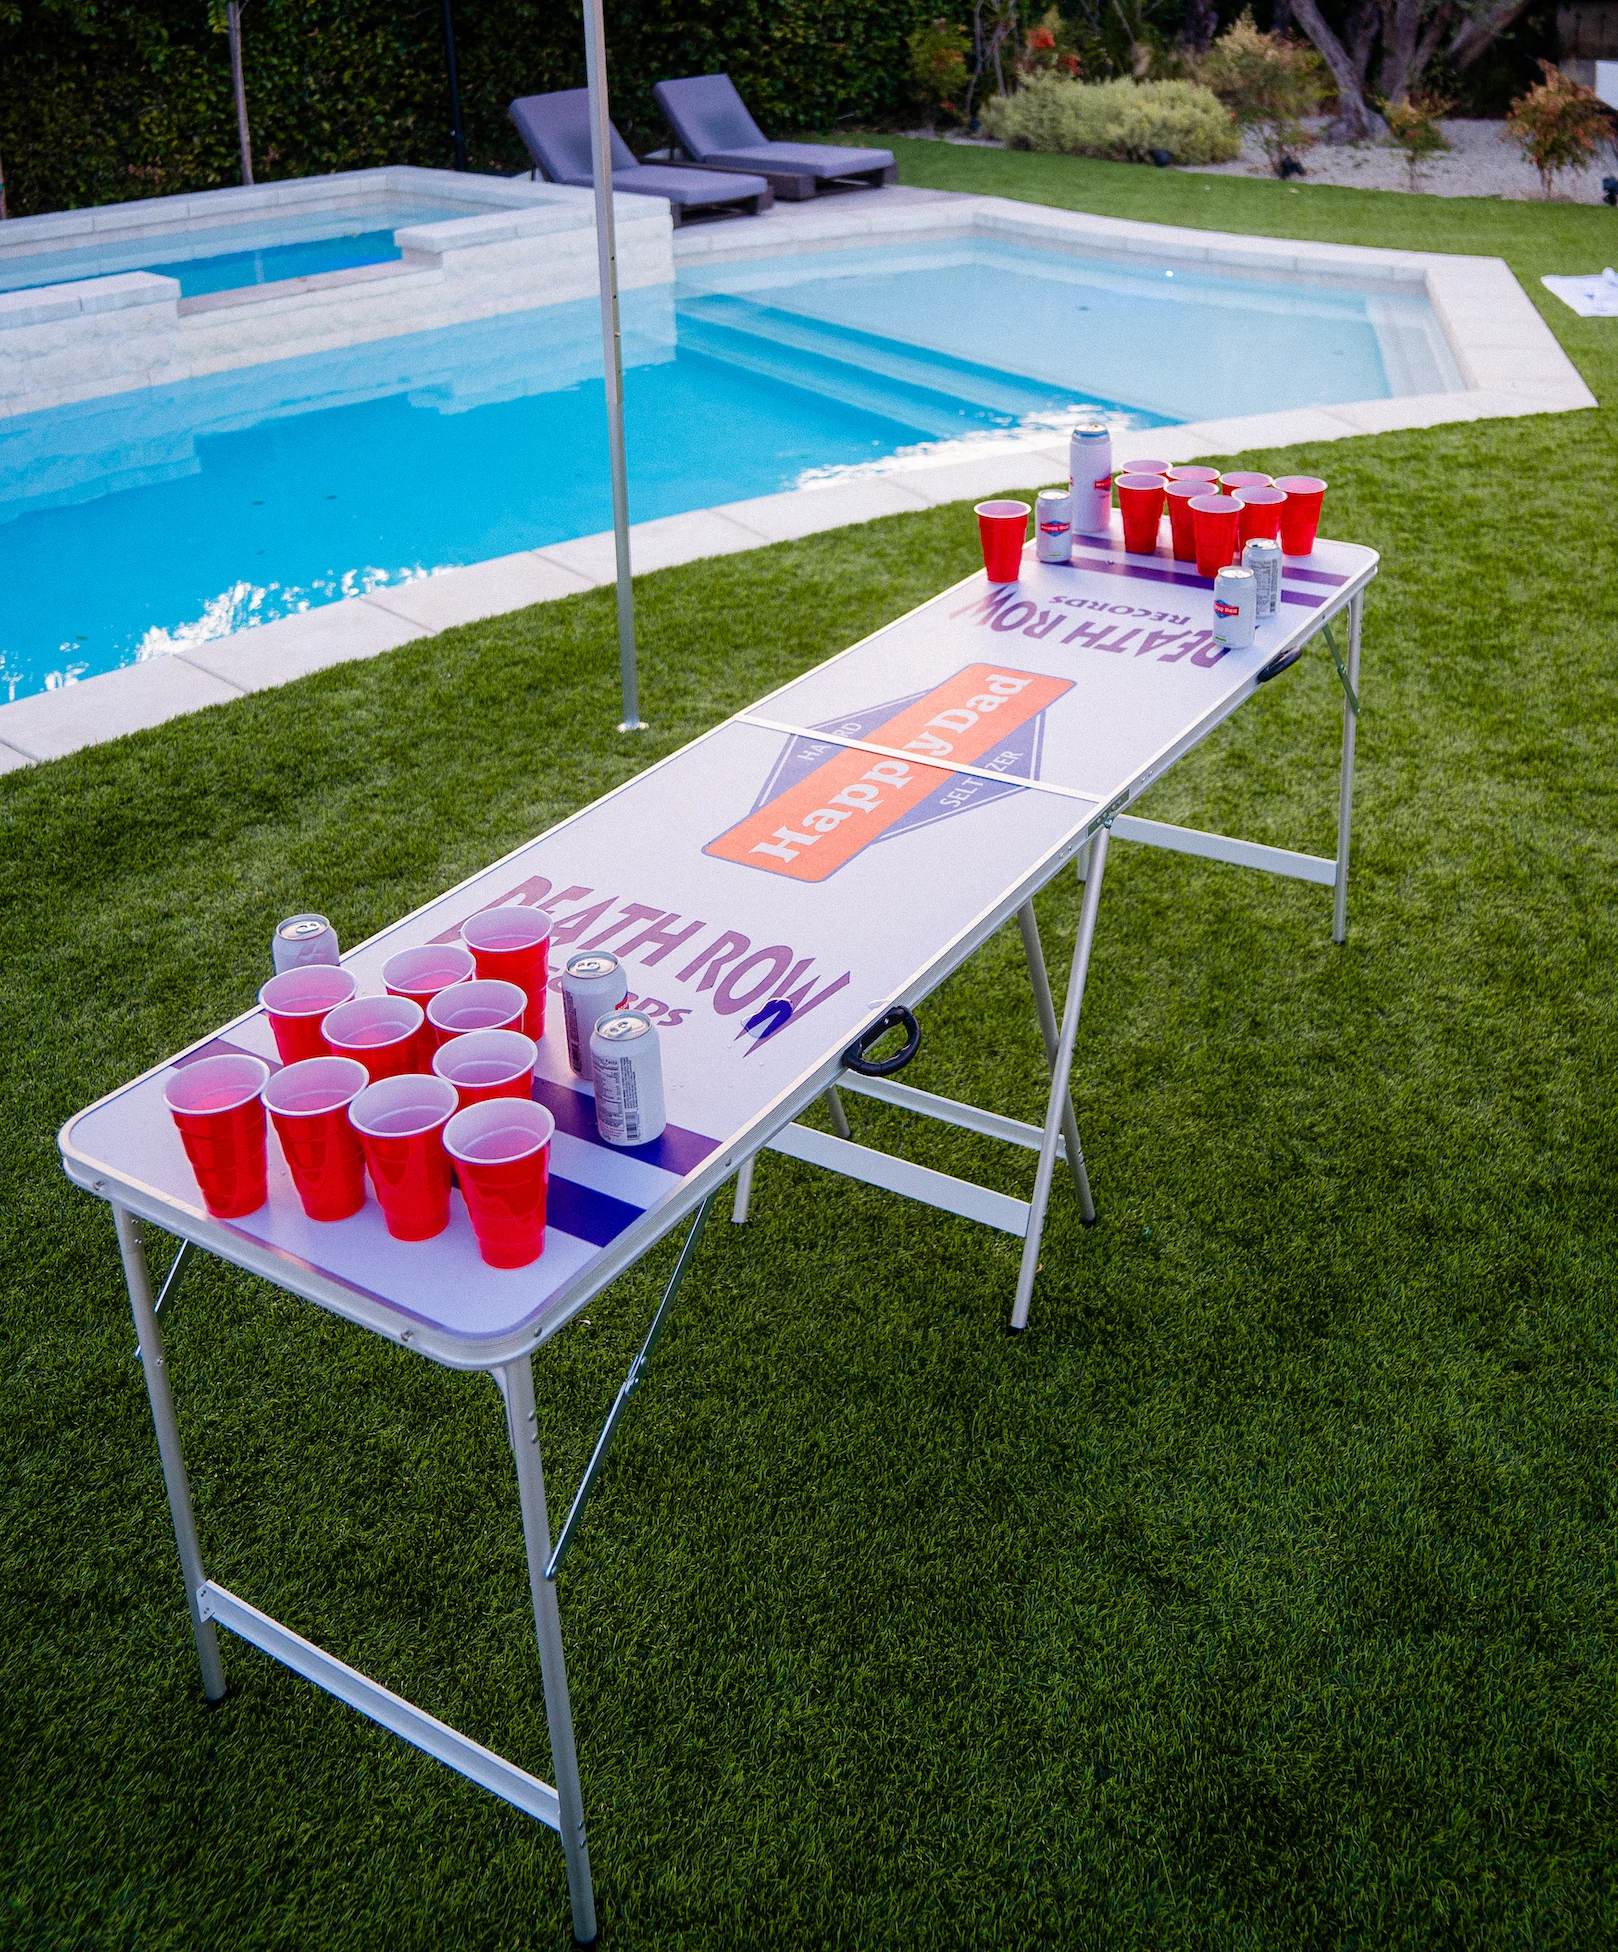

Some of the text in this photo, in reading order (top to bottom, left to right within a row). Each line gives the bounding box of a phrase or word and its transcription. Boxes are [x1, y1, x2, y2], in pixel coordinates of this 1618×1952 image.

[949, 585, 1067, 639] ROW
[1049, 595, 1191, 626] RECORDS
[747, 674, 1034, 864] Happy Dad
[797, 722, 862, 761] HARD
[939, 751, 1025, 808] SELTZER
[675, 930, 851, 1058] ROW
